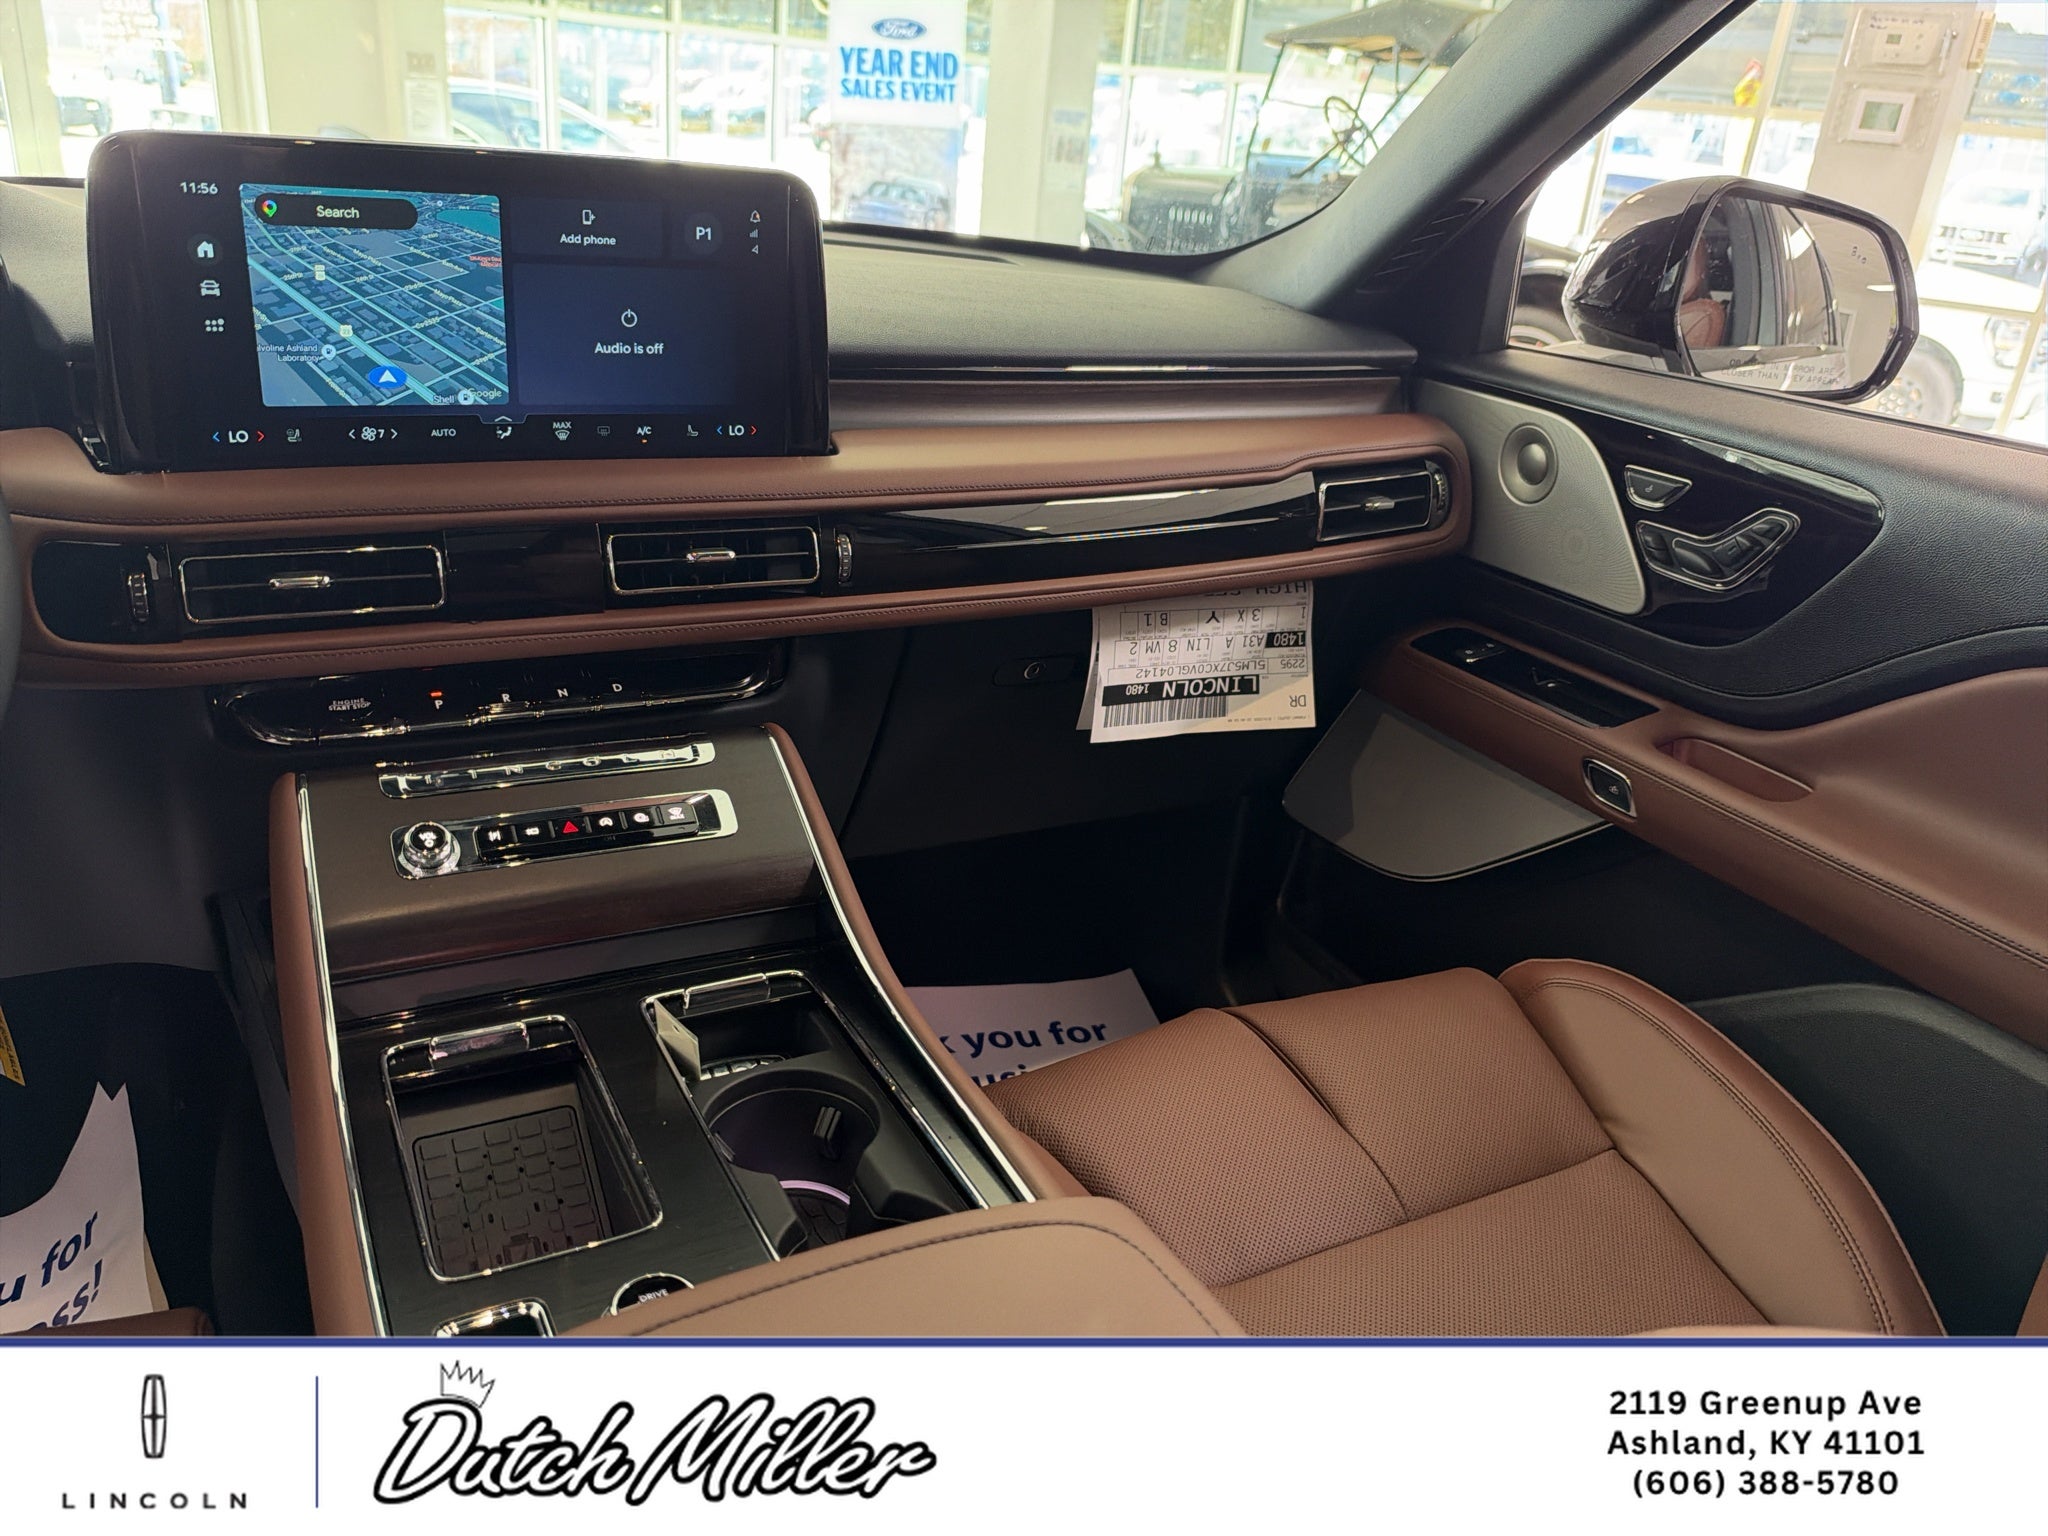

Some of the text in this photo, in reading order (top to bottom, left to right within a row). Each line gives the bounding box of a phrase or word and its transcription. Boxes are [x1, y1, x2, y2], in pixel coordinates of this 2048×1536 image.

[840, 46, 959, 80] YEAR END
[840, 78, 956, 103] SALES EVENT
[180, 182, 218, 195] 11:56
[316, 205, 360, 219] Search
[695, 226, 712, 241] P1
[560, 234, 616, 249] Add phone
[286, 343, 318, 352] Ashland
[594, 342, 664, 354] Audio is off
[277, 354, 320, 363] Laboratory
[433, 395, 455, 404] Shell
[467, 387, 502, 399] Google
[552, 421, 572, 429] MAX
[636, 425, 652, 436] A/C
[728, 424, 745, 436] LO
[229, 430, 249, 443] LO
[377, 429, 385, 438] 7
[431, 428, 457, 437] AUTO
[1143, 613, 1152, 627] 1
[1159, 612, 1169, 626] B
[1205, 610, 1222, 624] Y
[1237, 608, 1245, 622] X
[1251, 608, 1261, 622] 3
[1168, 638, 1178, 652] 8
[1186, 637, 1211, 651] LIN
[1225, 636, 1234, 649] A
[1242, 634, 1266, 648] A31
[1273, 631, 1305, 647] 1480
[1128, 641, 1138, 656] 2
[1145, 640, 1162, 654] VM
[1280, 658, 1305, 670] 2295
[1125, 675, 1258, 698] LINCOLN 1480
[332, 697, 365, 705] ENGINE
[434, 683, 623, 710] P R N D
[1289, 695, 1307, 708] DR
[352, 701, 372, 710] STOP
[418, 831, 438, 842] VOL
[960, 1029, 1043, 1058] you
[1047, 1020, 1108, 1046] for
[41, 1210, 99, 1289] for
[638, 1288, 669, 1303] DRIVE
